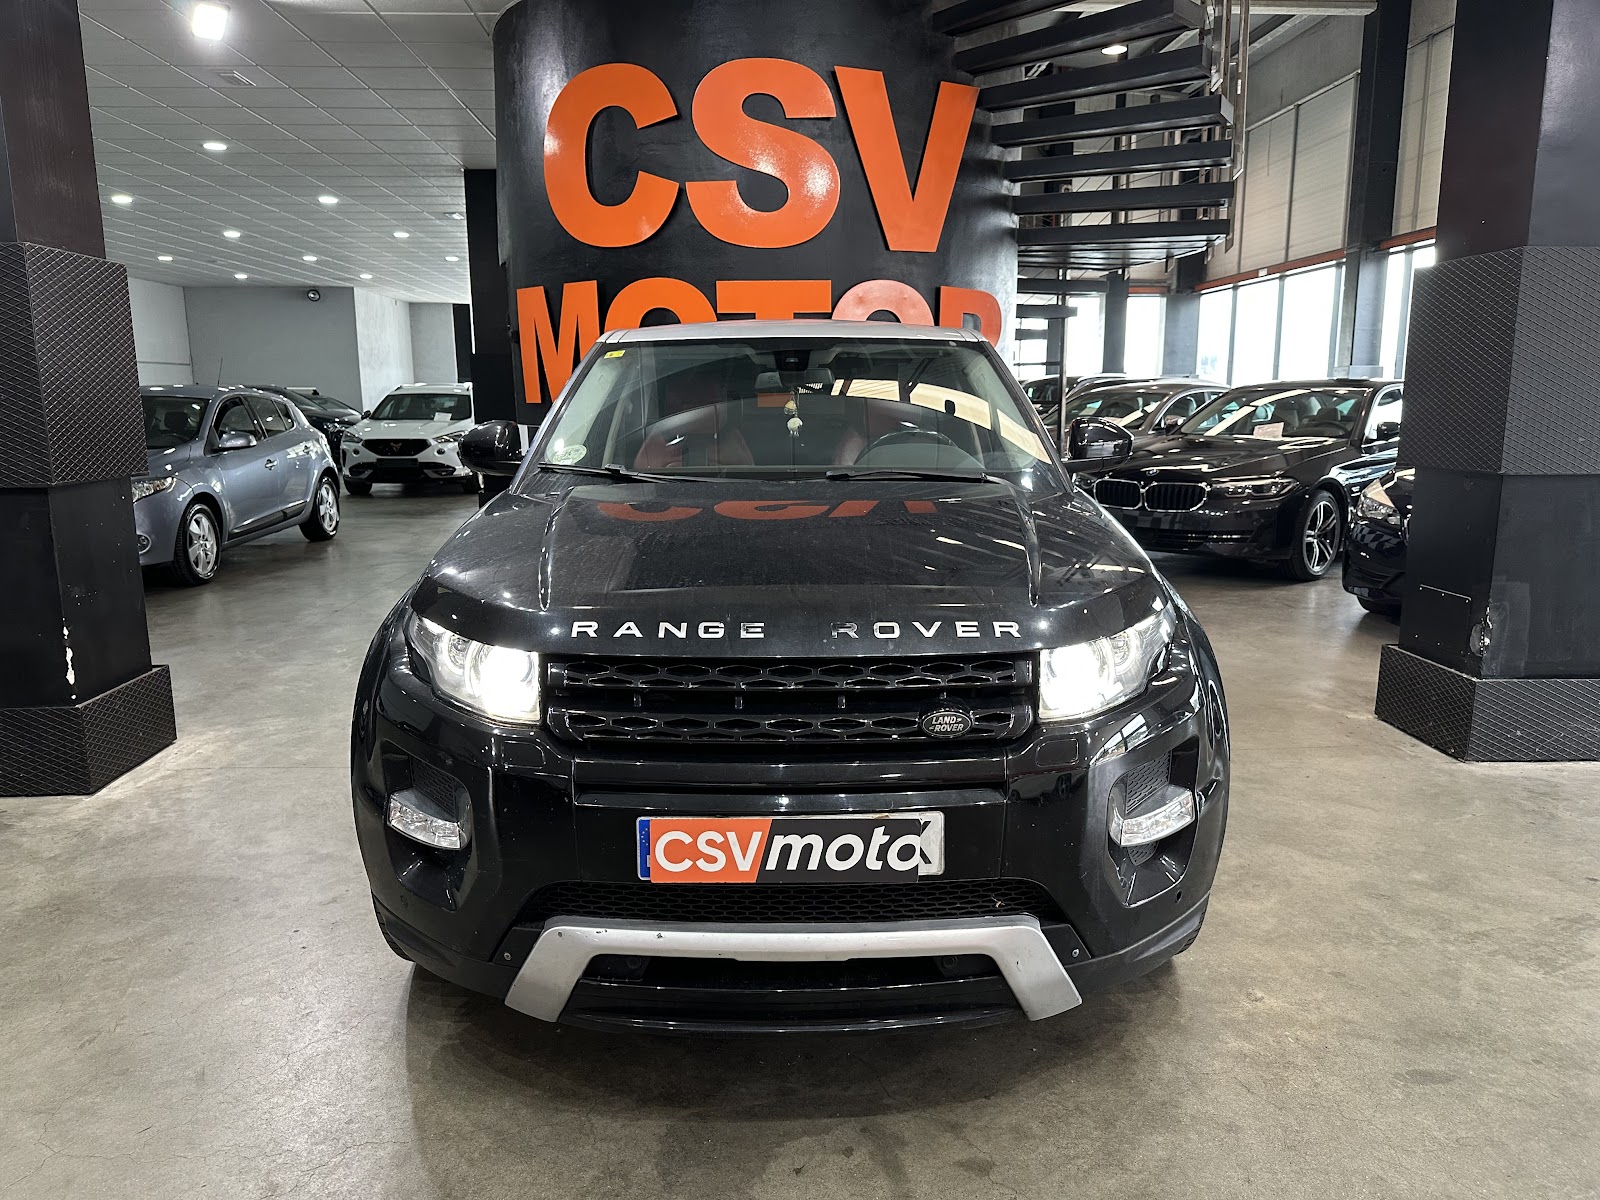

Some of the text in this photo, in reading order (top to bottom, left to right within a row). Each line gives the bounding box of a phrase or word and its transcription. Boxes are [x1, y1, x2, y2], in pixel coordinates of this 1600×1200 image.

[543, 57, 979, 252] CSV
[570, 621, 1022, 639] RANGE ROVER
[932, 716, 957, 724] LAND
[933, 724, 964, 732] ROVER
